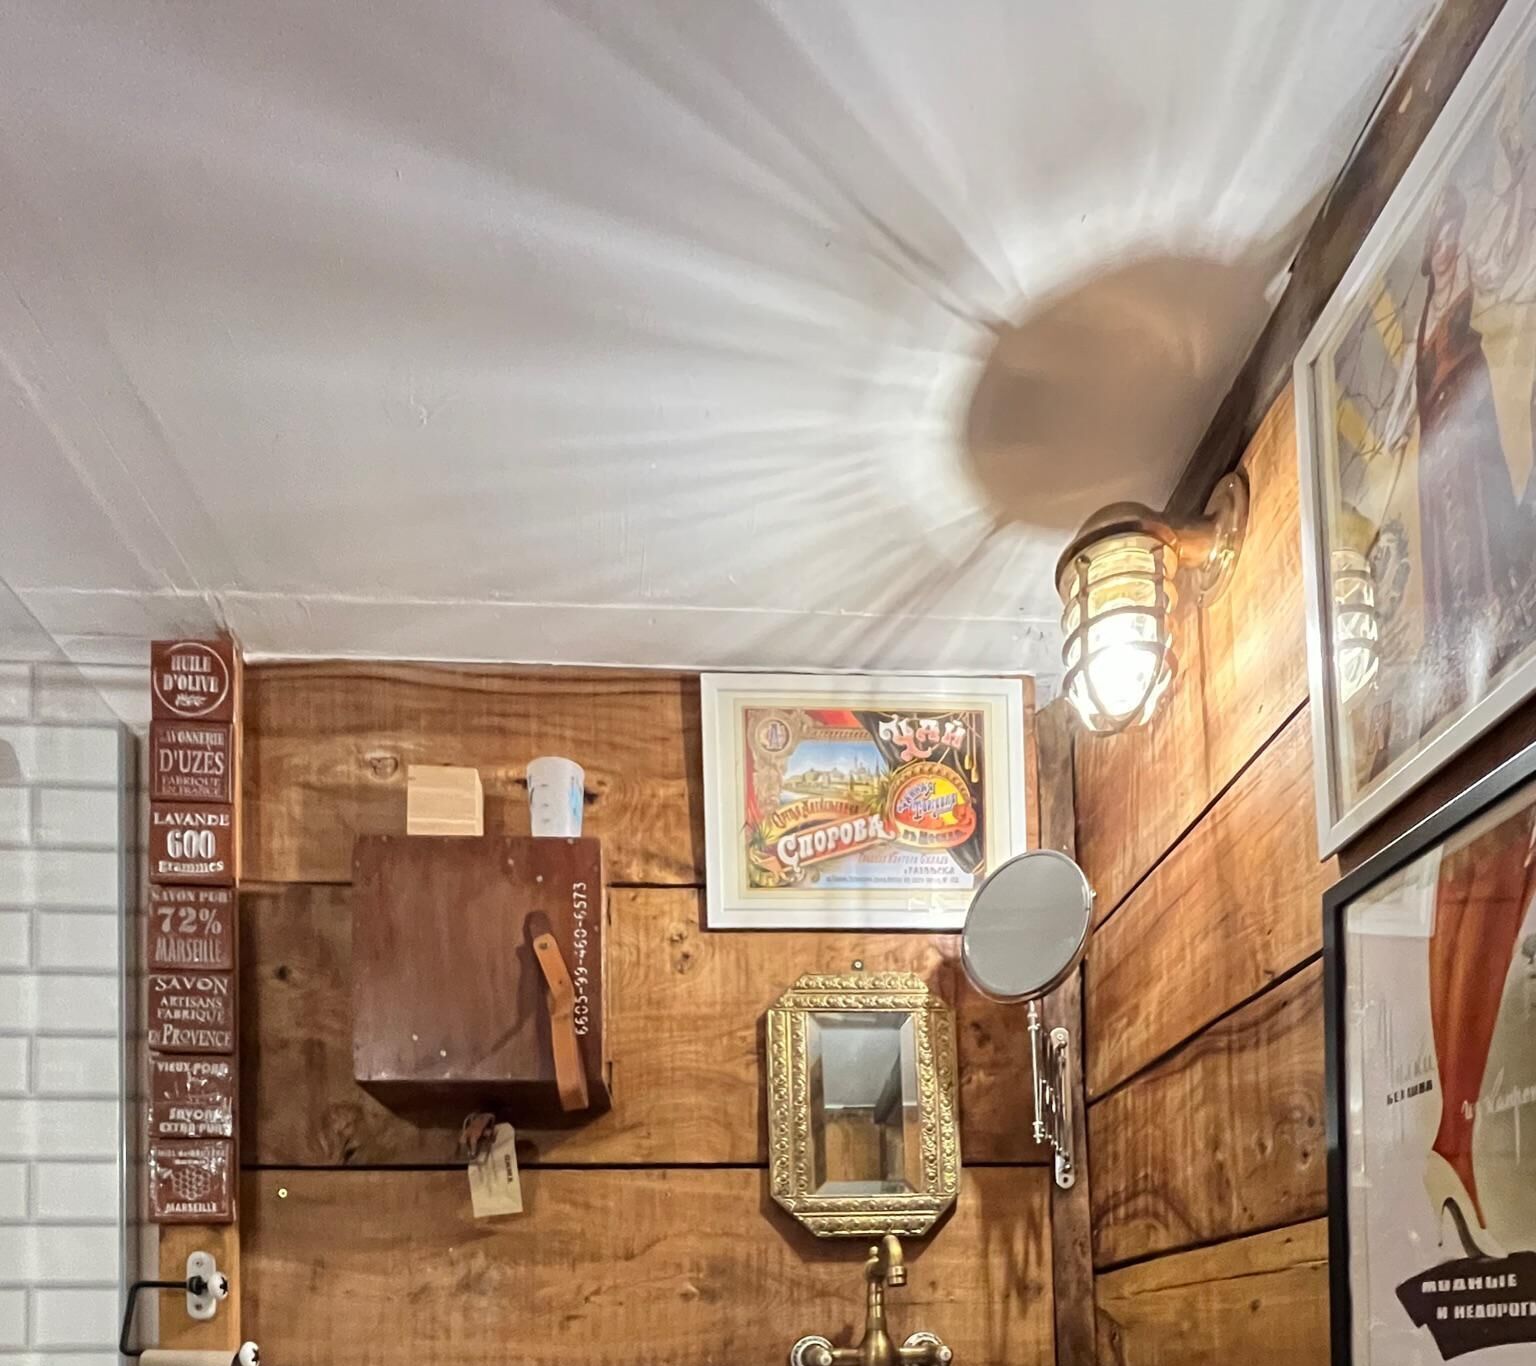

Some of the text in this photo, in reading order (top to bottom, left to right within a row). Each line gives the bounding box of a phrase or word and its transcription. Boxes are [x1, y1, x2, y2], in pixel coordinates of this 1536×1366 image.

[171, 655, 212, 673] HUILE
[163, 673, 219, 693] D'OLIVE
[161, 730, 225, 746] AVONNERIE
[153, 812, 230, 826] LAVANDE
[166, 829, 216, 859] 600
[151, 890, 196, 902] SAVON
[157, 906, 223, 934] 72%
[155, 936, 222, 963] MARSEILLE
[572, 882, 589, 1035] 6605-99-460-6573
[154, 977, 228, 995] SAVON
[160, 995, 222, 1009] ARTISANS
[162, 1023, 231, 1047] PROVENCE
[157, 1062, 191, 1073] VIEUX
[165, 1201, 217, 1213] MARSEILLE
[1422, 1273, 1518, 1293] МОДНЫЕ
